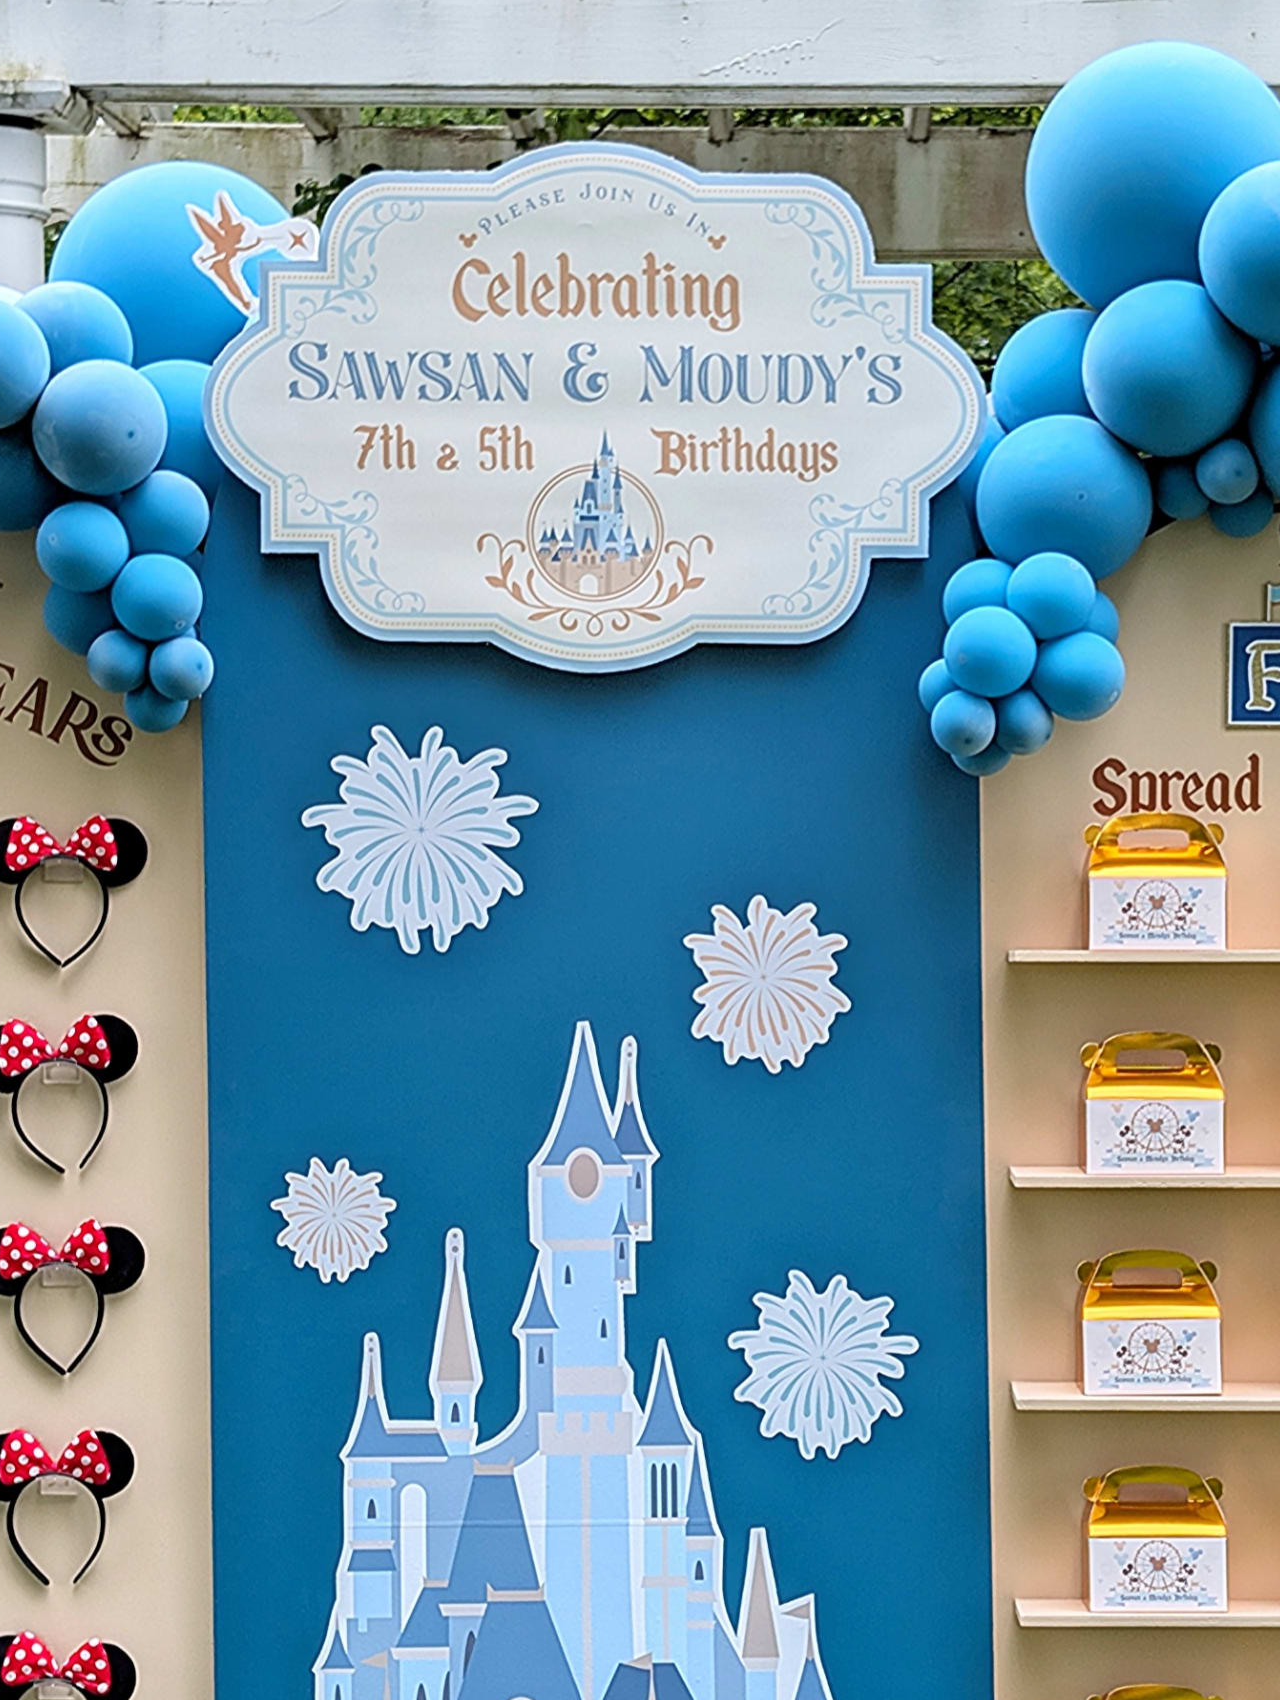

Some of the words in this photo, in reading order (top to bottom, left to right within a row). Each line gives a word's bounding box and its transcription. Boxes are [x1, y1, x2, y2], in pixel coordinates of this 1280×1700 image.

[452, 251, 741, 332] Celebrating
[562, 341, 609, 402] &
[353, 424, 416, 471] 7th
[436, 443, 459, 471] &
[478, 424, 535, 472] 5th
[651, 427, 838, 482] Birthdays
[1091, 753, 1261, 816] Spread
